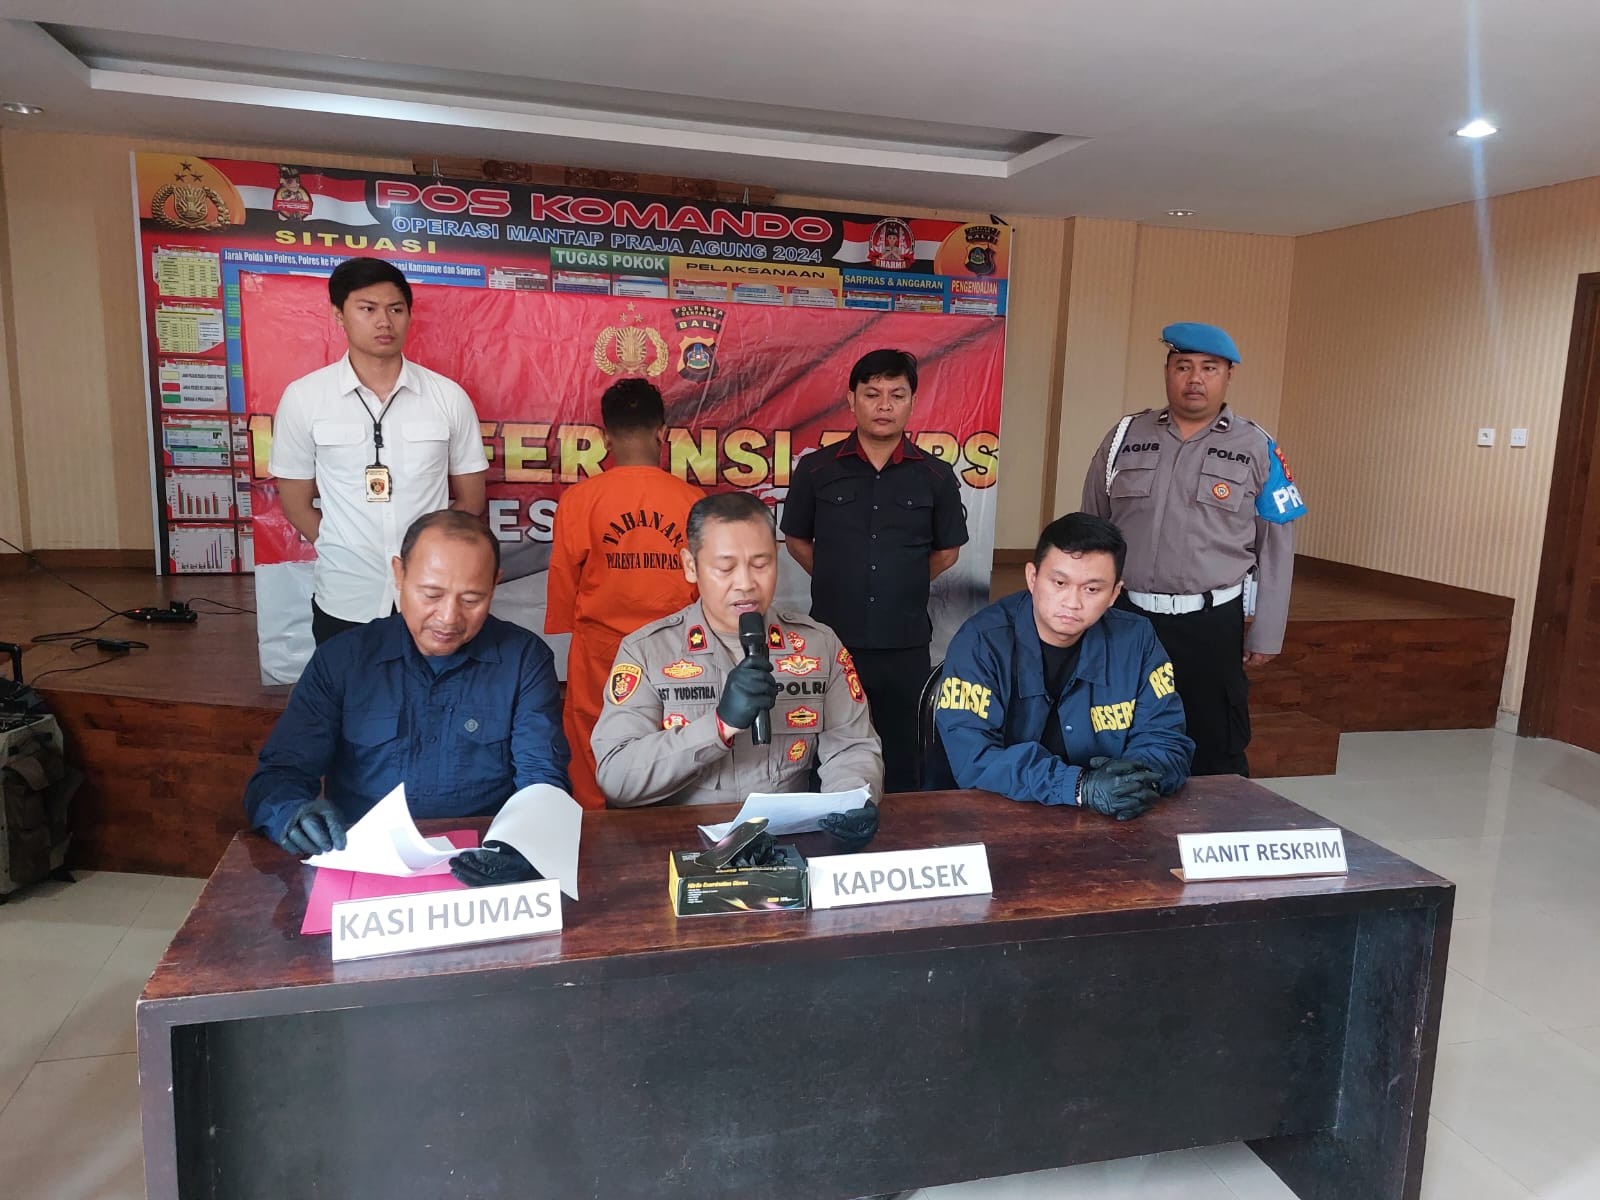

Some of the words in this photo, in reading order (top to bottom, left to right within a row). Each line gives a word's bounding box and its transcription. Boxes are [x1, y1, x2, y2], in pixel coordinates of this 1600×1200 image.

[375, 179, 512, 218] POS
[530, 193, 832, 243] KOMANDO
[274, 229, 438, 254] SITUASI
[392, 215, 499, 239] OPERASI
[507, 224, 604, 247] MANTAP
[610, 227, 685, 254] PRAJA
[690, 238, 768, 259] AGUNG
[772, 244, 823, 263] 2024
[408, 261, 443, 275] Kampanye
[443, 263, 457, 275] dan
[456, 265, 482, 277] Sarpras
[555, 250, 608, 266] TUGAS
[612, 254, 665, 271] POKOK
[686, 262, 826, 279] PELAKSANAAN
[844, 274, 886, 287] SARPRAS
[887, 276, 895, 287] &
[896, 276, 944, 290] ANGGARAN
[951, 279, 998, 295] PENGENDALIAN
[679, 319, 718, 331] BALI
[1122, 442, 1160, 454] AGUS
[1207, 447, 1251, 465] POLRI
[1192, 844, 1250, 864] KANIT
[1257, 840, 1342, 862] RESKRIM
[832, 863, 968, 897] KAPOLSEK
[340, 907, 414, 941] KASI
[428, 892, 552, 931] HUMAS
